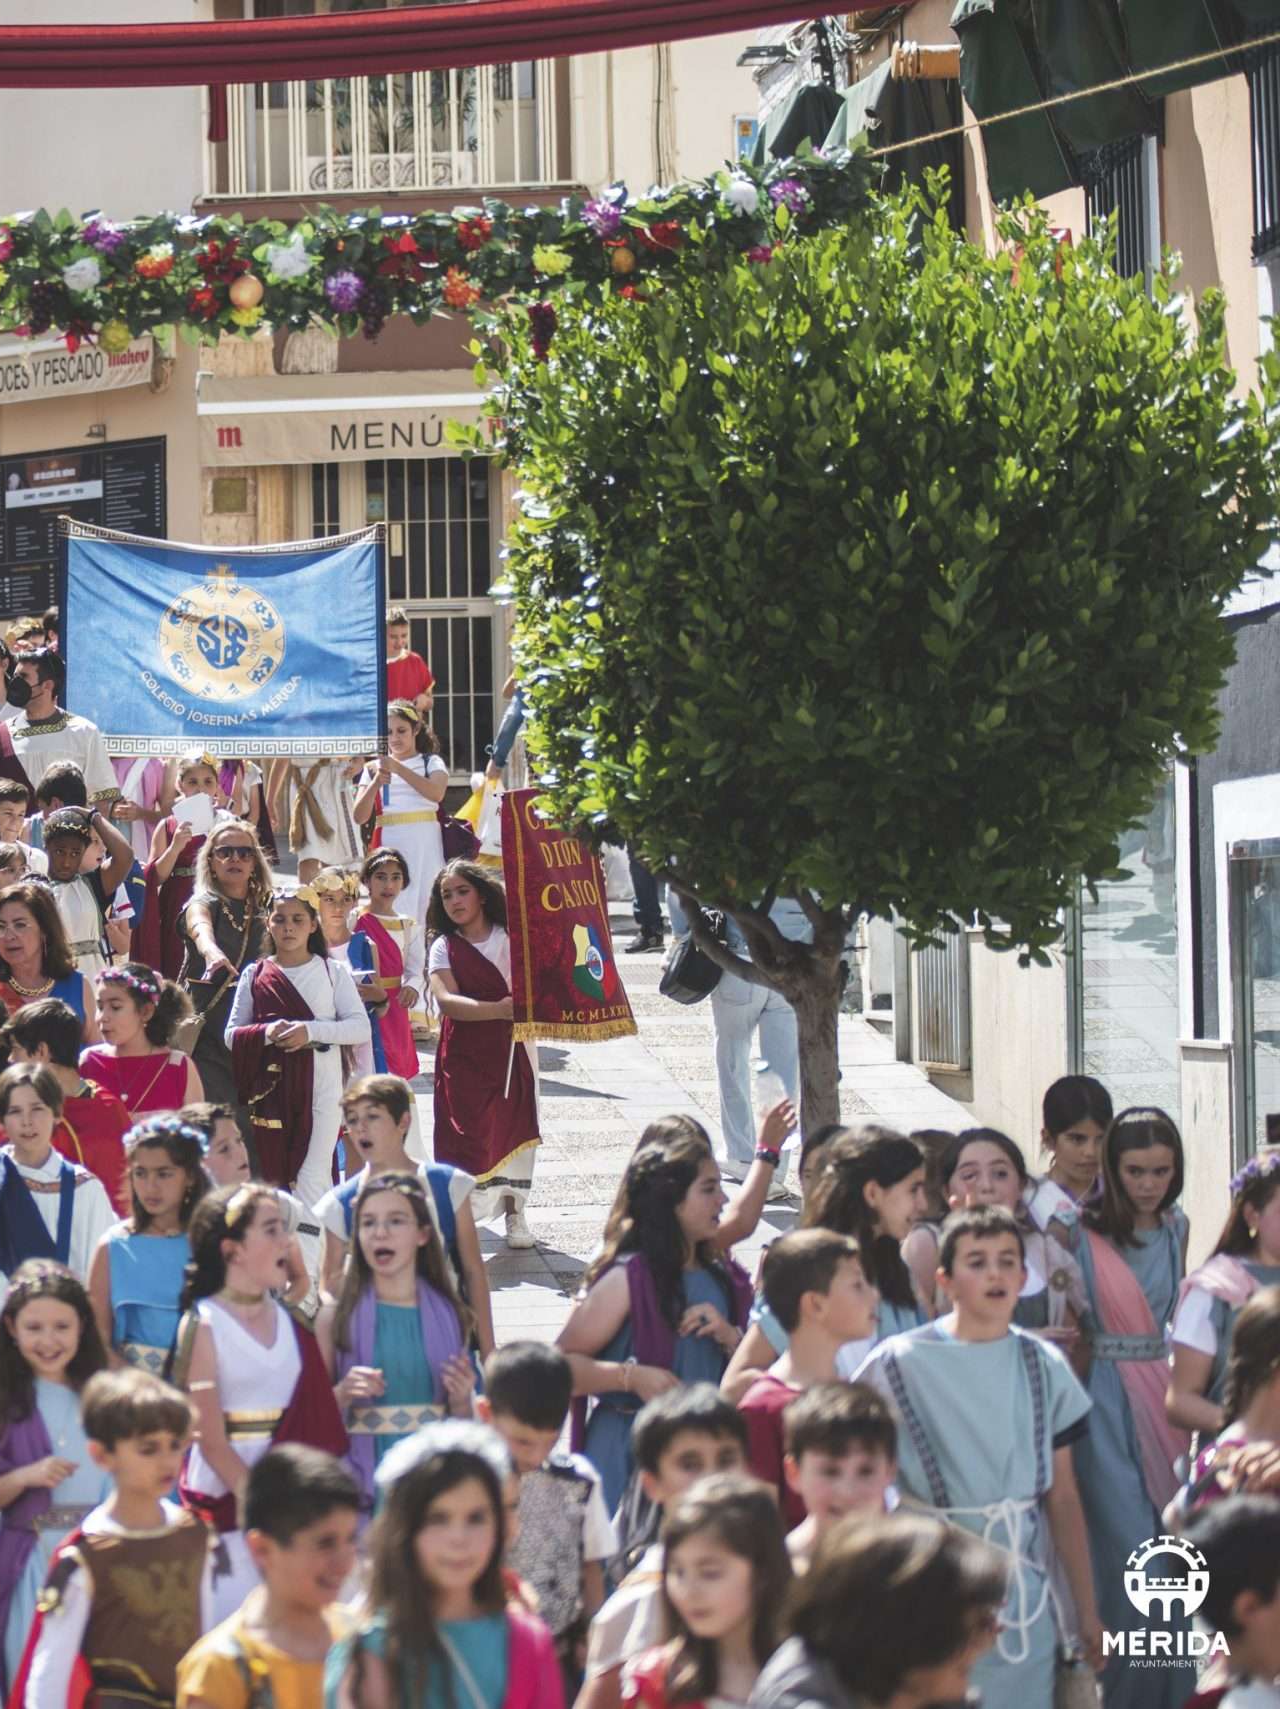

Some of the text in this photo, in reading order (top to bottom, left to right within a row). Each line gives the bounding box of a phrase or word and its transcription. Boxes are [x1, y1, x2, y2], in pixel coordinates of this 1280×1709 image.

[31, 361, 42, 388] Y
[43, 351, 103, 387] PESCADO
[330, 414, 443, 451] MENÚ
[141, 670, 185, 716] COLEGIO
[186, 708, 257, 726] JOSEFINAS
[540, 838, 583, 868] DION
[541, 880, 598, 912] CASIO
